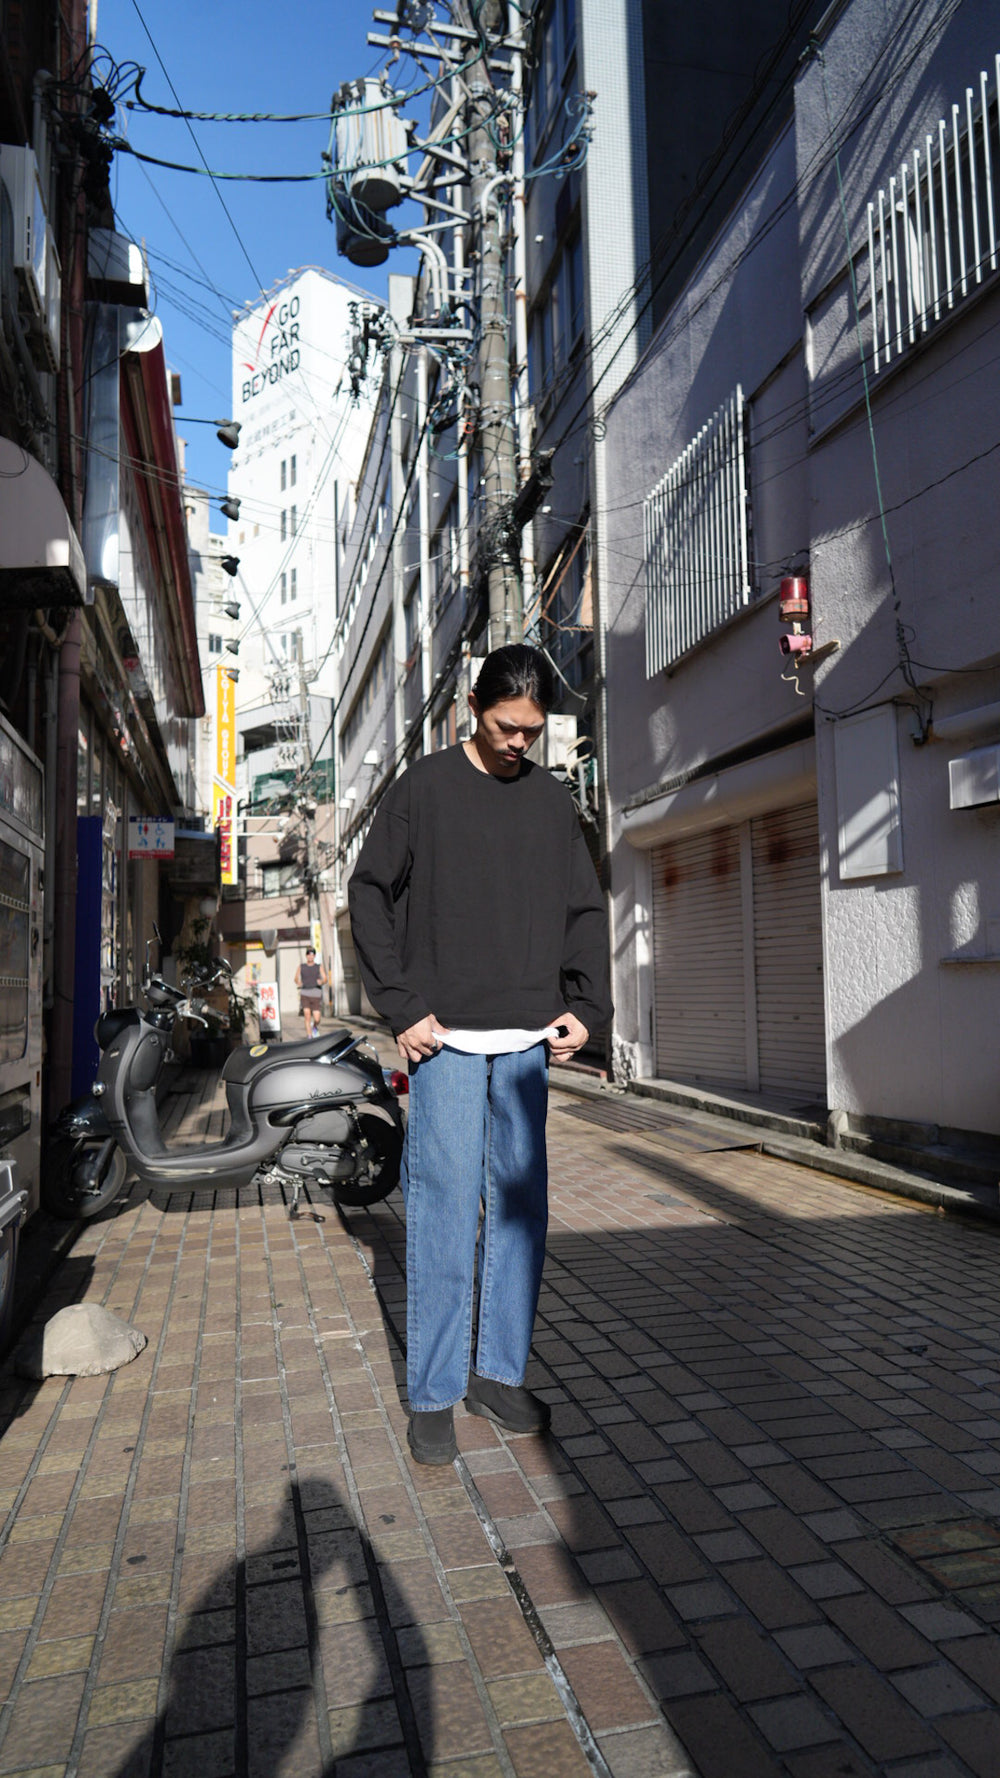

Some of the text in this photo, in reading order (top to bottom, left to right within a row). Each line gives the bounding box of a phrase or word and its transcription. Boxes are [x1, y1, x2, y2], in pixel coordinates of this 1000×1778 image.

[279, 295, 300, 326] GO
[270, 322, 301, 360] FAR
[241, 348, 301, 404] BEYOND
[220, 729, 231, 780] GROUP
